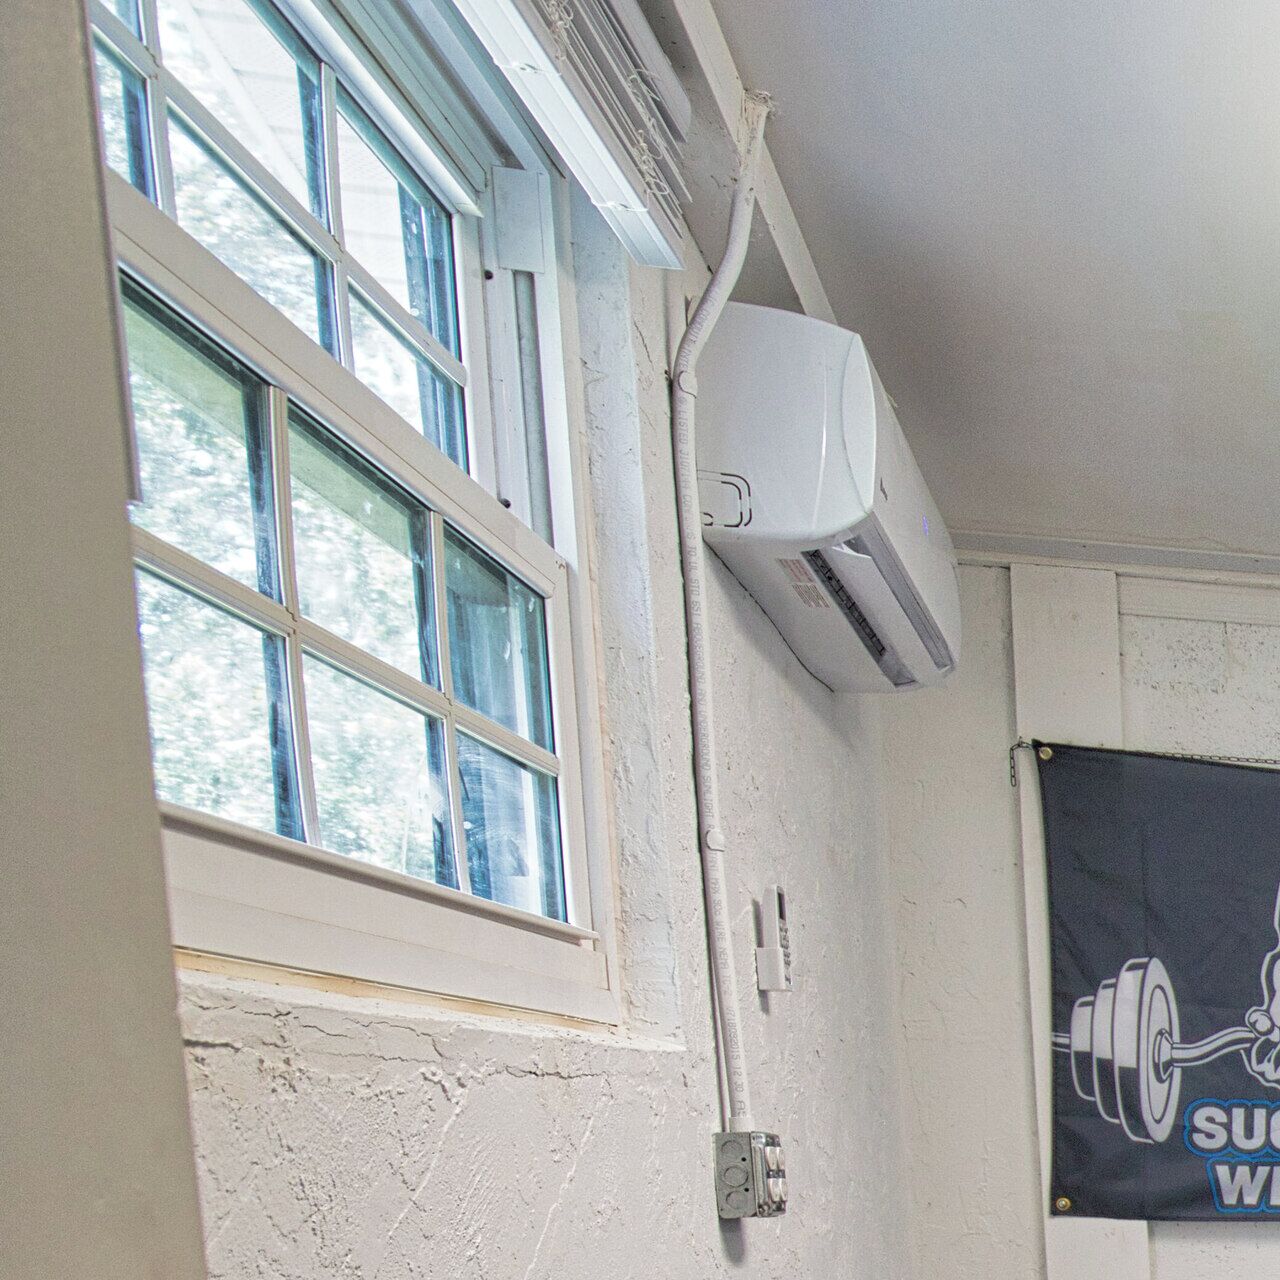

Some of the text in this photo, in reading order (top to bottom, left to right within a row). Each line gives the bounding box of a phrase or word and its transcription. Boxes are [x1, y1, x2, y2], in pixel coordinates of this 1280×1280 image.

[677, 410, 690, 444] LISTED
[702, 774, 714, 818] SUNLIGHT
[714, 920, 727, 942] WIRE
[717, 946, 730, 969] NEMA
